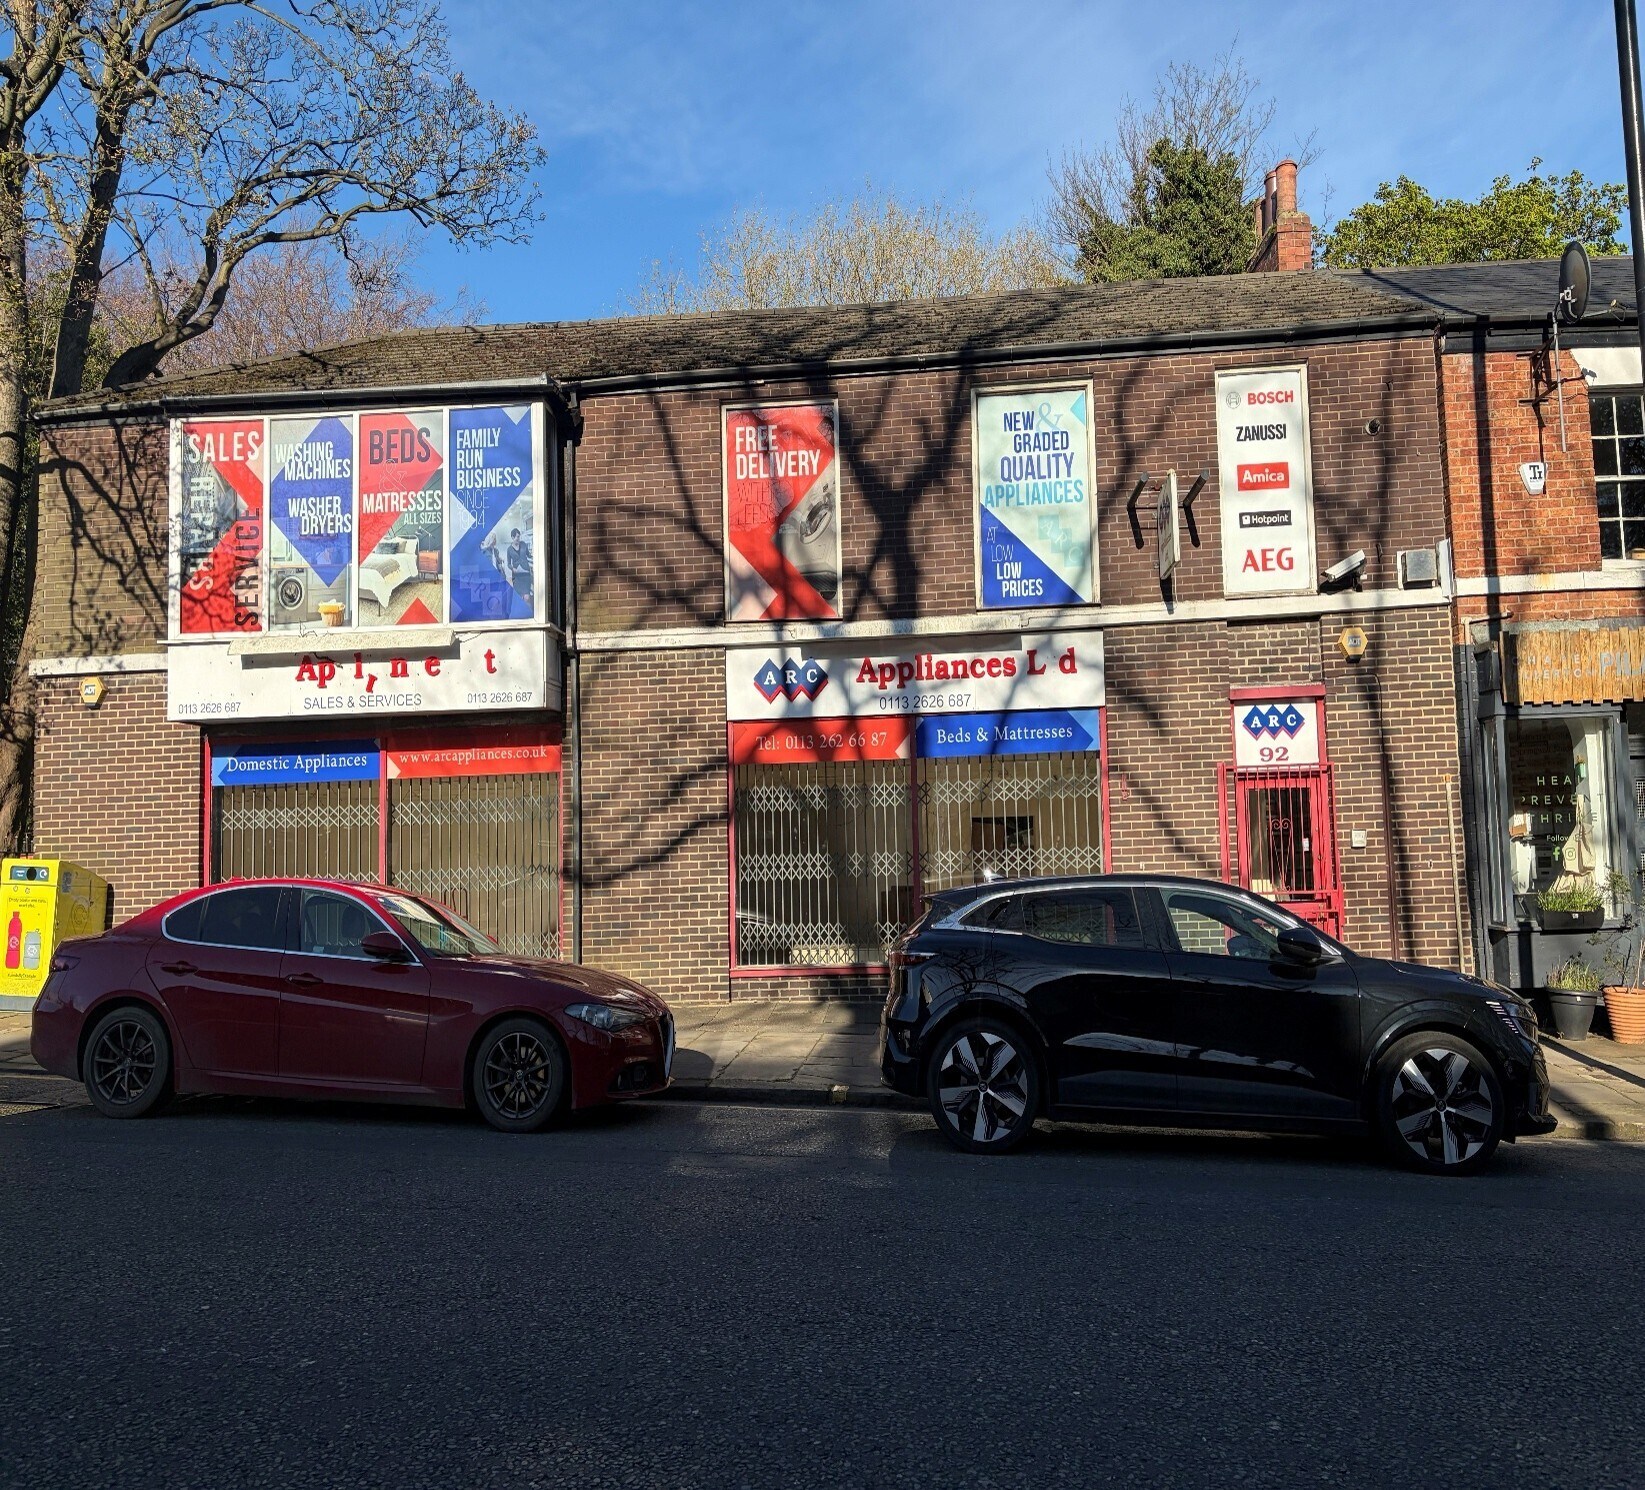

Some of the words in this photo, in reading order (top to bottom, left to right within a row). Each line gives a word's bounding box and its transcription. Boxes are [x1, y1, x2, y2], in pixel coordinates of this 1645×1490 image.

[1247, 390, 1294, 406] BOSCH
[1003, 411, 1035, 432] NEW
[1036, 402, 1063, 433] &
[456, 427, 502, 449] FAMILY
[735, 425, 779, 453] FREE
[1013, 430, 1069, 453] GRADED
[1236, 423, 1287, 442] ZANUSSI
[188, 431, 260, 463] SALES
[275, 440, 334, 463] WASHING
[369, 427, 431, 465] BEDS
[456, 449, 483, 469] RUN
[736, 449, 822, 480] DELIVERY
[1000, 452, 1074, 482] QUALITY
[285, 459, 351, 481] MACHINES
[456, 466, 521, 489] BUSINESS
[1242, 468, 1284, 484] Amica
[363, 489, 442, 514] MATRESSES
[456, 488, 490, 510] SINCE
[984, 479, 1084, 508] APPLIANCES
[288, 496, 341, 518] WASHER
[301, 513, 352, 535] DRYERS
[404, 513, 419, 526] ALL
[419, 511, 442, 525] SIZES
[458, 508, 486, 529] 1994
[1251, 514, 1289, 525] Hotpoint
[190, 476, 215, 590] REPAIRS
[986, 526, 998, 544] AT
[990, 544, 1014, 562] LOW
[1242, 547, 1294, 573] AEG
[235, 508, 260, 626] SERVICE
[996, 562, 1022, 580] LOW
[1002, 579, 1044, 598] PRICES
[856, 652, 1017, 690] Appliances
[84, 686, 96, 695] ADT
[304, 695, 345, 709] SALES
[347, 695, 356, 709] &
[358, 693, 422, 708] SERVICES
[467, 693, 488, 705] 0113
[490, 692, 512, 704] 2626
[515, 691, 533, 703] 687
[178, 703, 198, 714] 0113
[200, 702, 221, 713] 2626
[223, 701, 241, 713] 687
[879, 695, 909, 711] 0113
[912, 694, 945, 709] 2626
[948, 693, 972, 708] 687
[756, 736, 780, 751] Tel:
[785, 734, 814, 750] 0113
[819, 733, 844, 749] 262
[849, 732, 866, 748] 66
[871, 732, 887, 747] 87
[936, 728, 971, 745] Beds
[976, 727, 989, 743] &
[994, 725, 1073, 742] Mattresses
[227, 756, 290, 772] Domestic
[294, 753, 367, 772] Appliances
[399, 745, 548, 766] www.arcappliances.co.uk
[1259, 746, 1289, 762] 92
[1529, 812, 1598, 823] THRIE
